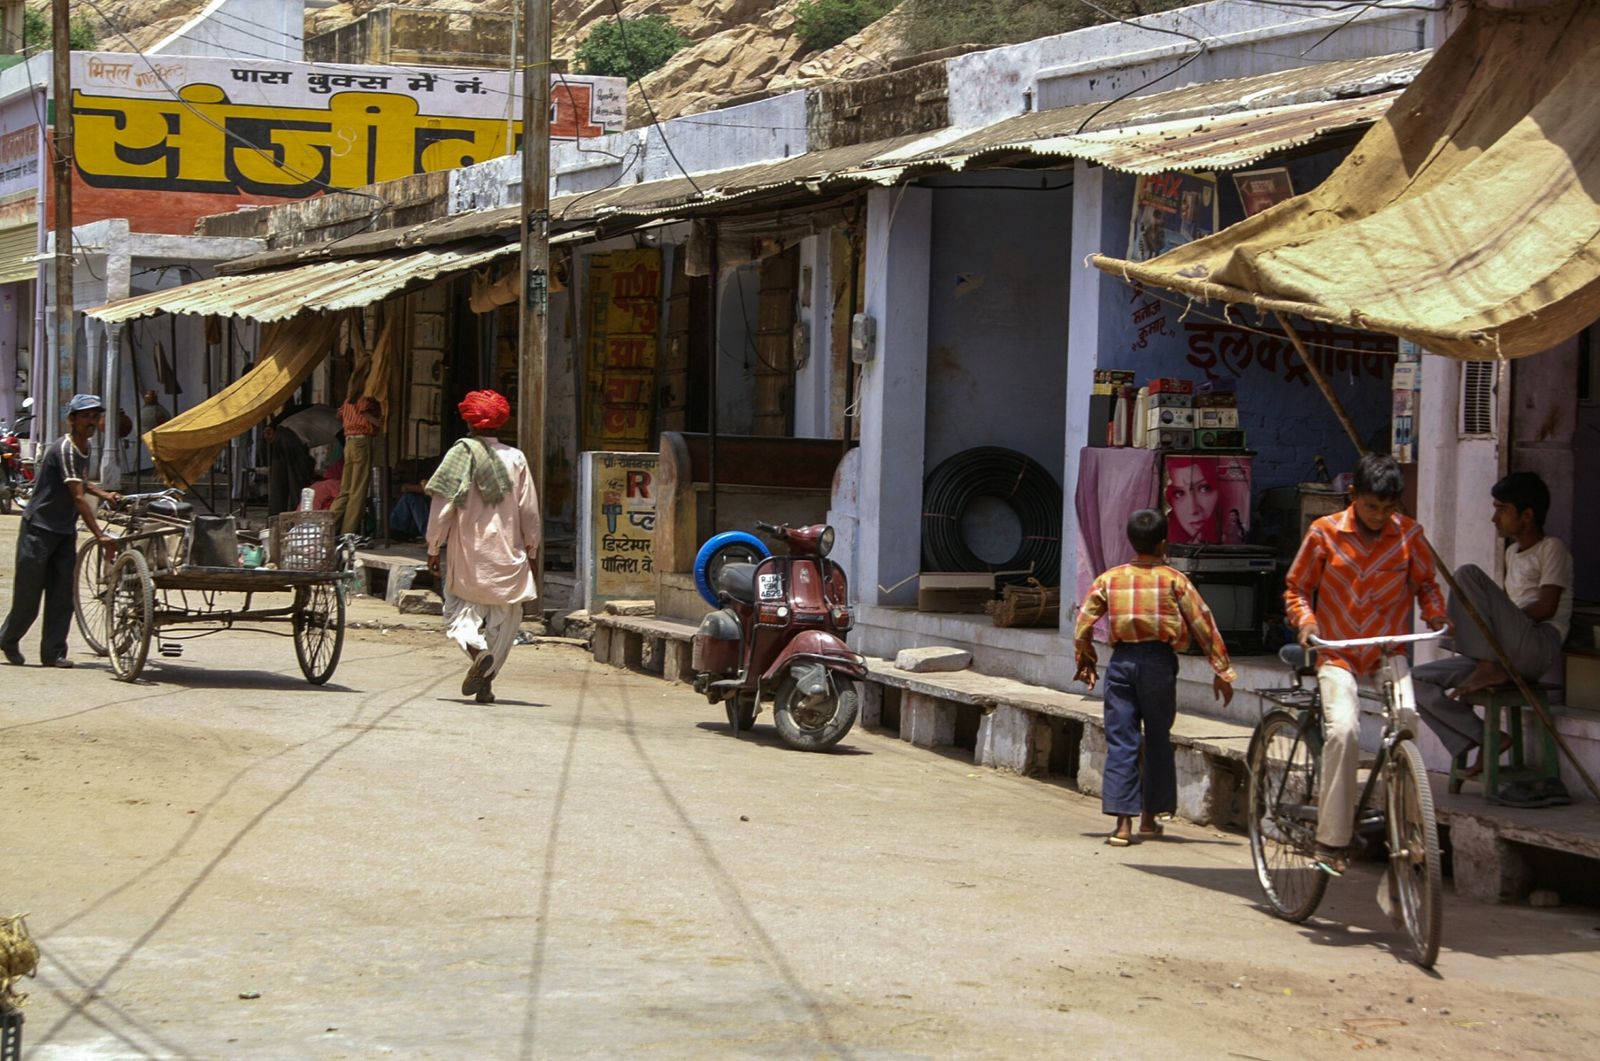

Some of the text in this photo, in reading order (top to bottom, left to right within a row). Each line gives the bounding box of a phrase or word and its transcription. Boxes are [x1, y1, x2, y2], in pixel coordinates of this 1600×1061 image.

[230, 68, 292, 85] पास
[307, 72, 392, 94] बुक्स
[408, 73, 441, 93] में
